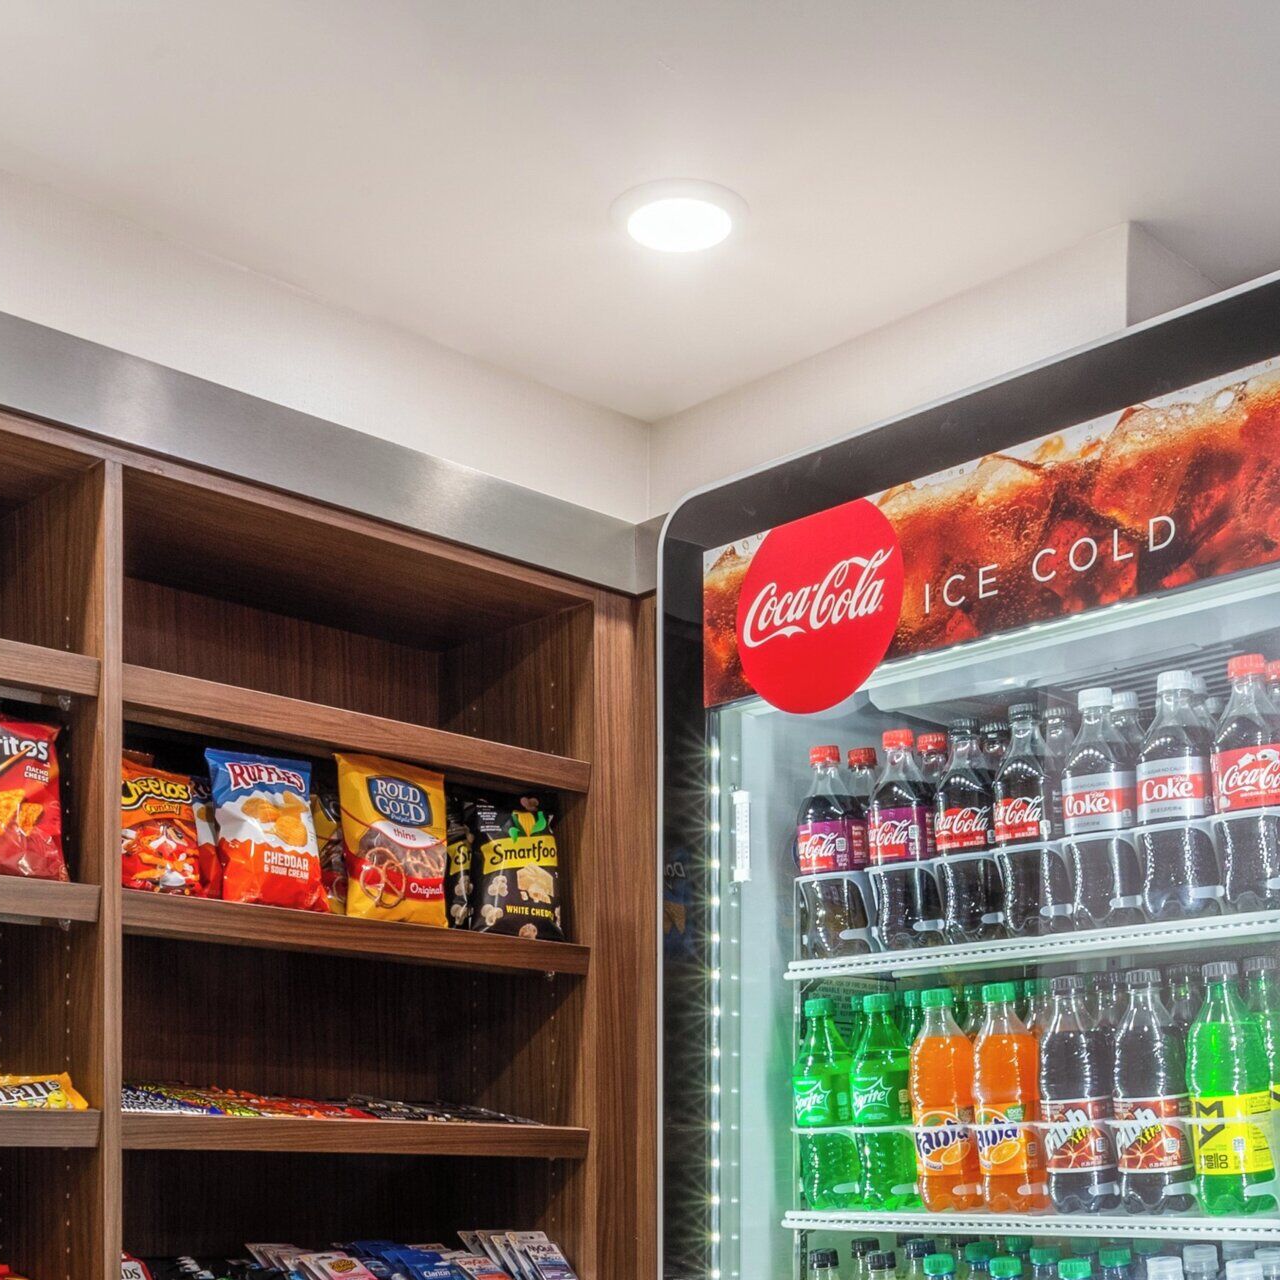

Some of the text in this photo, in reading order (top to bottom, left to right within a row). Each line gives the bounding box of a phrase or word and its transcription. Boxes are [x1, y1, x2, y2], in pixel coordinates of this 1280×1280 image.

[924, 515, 1176, 613] ICE COLD
[742, 545, 894, 648] Coca-Cola
[25, 765, 49, 776] NACHO
[226, 762, 306, 792] RUFFLES
[375, 780, 420, 803] ROLD
[1142, 781, 1194, 801] Coke
[375, 795, 426, 823] GOLD
[1065, 794, 1110, 817] Coke
[393, 826, 416, 842] thins
[264, 851, 309, 871] CHEDDAR
[270, 866, 309, 879] SOUR CREAM
[409, 882, 443, 898] Original
[506, 905, 529, 916] WHITE
[853, 1089, 886, 1107] Sprite
[423, 1270, 451, 1278] Claritin
